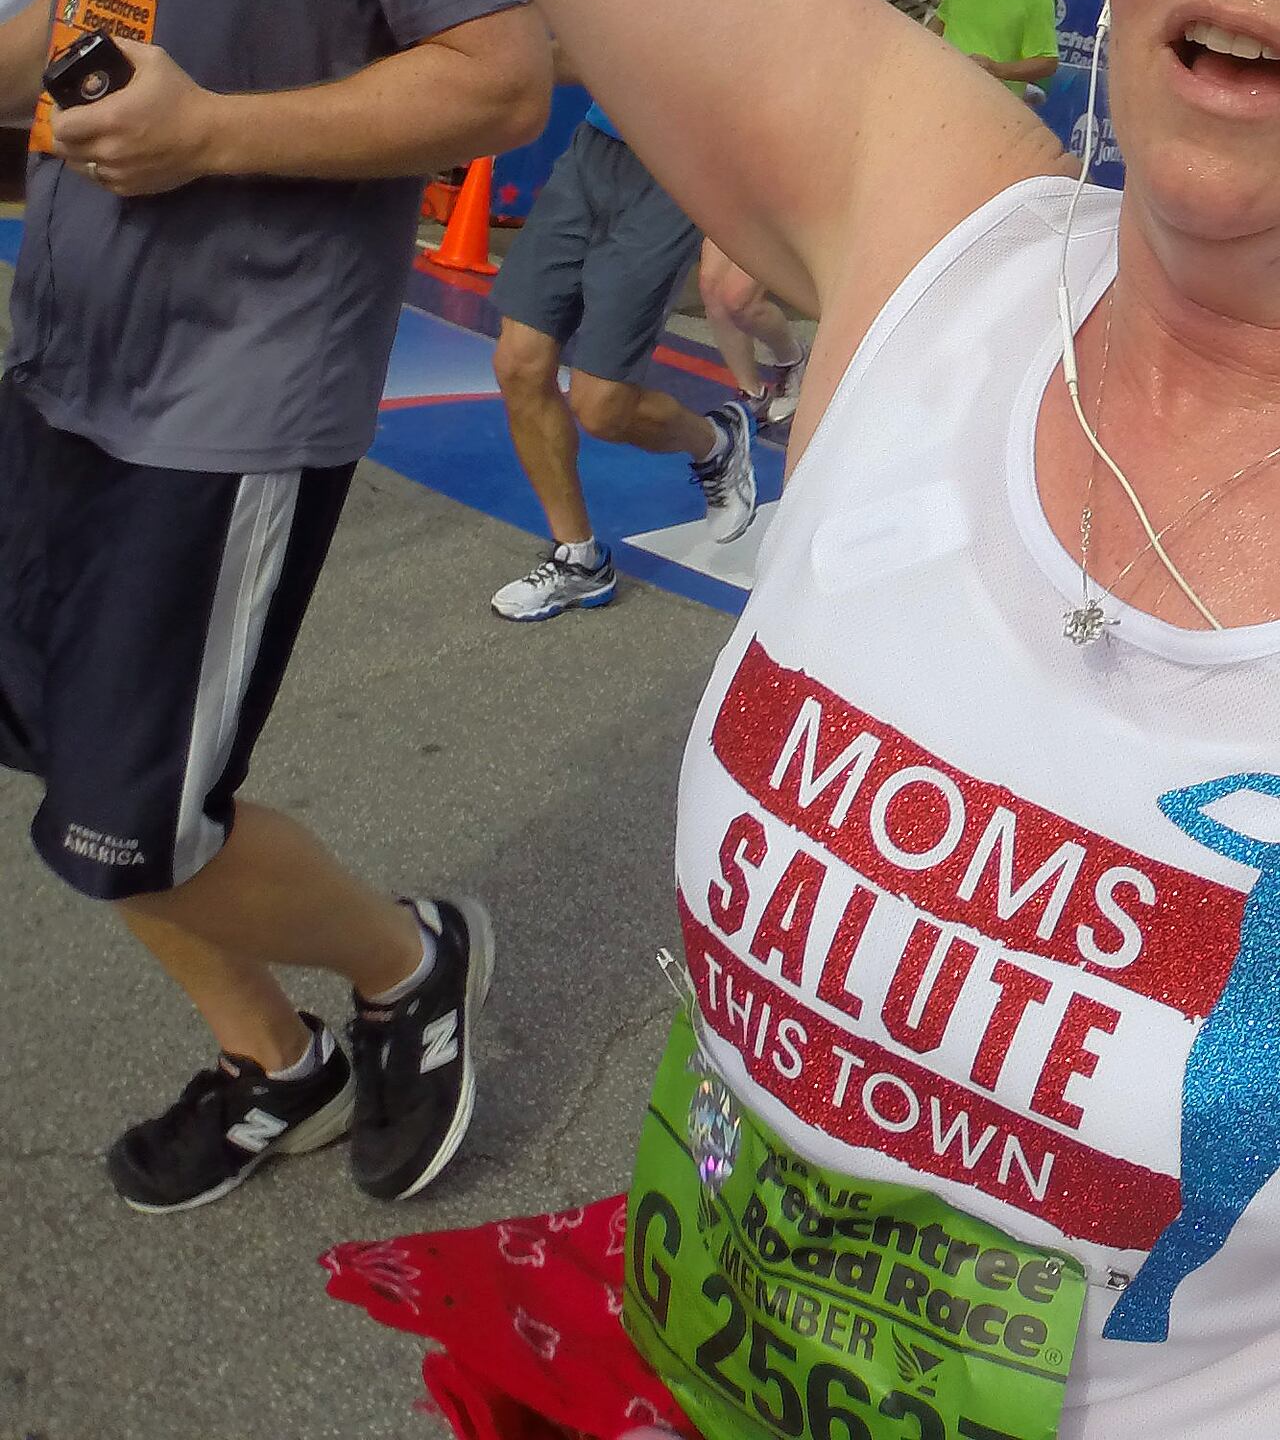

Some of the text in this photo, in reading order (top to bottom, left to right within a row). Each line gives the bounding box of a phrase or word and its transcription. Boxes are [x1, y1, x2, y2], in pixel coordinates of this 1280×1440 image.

[64, 833, 145, 866] AMERICA
[768, 695, 1157, 971] MOMS
[706, 811, 1123, 1130] SALUTE
[702, 951, 1054, 1204] THIS TOWN
[632, 1190, 682, 1329] G
[721, 1231, 879, 1362] MEMBER
[741, 1191, 1048, 1358] Road Race
